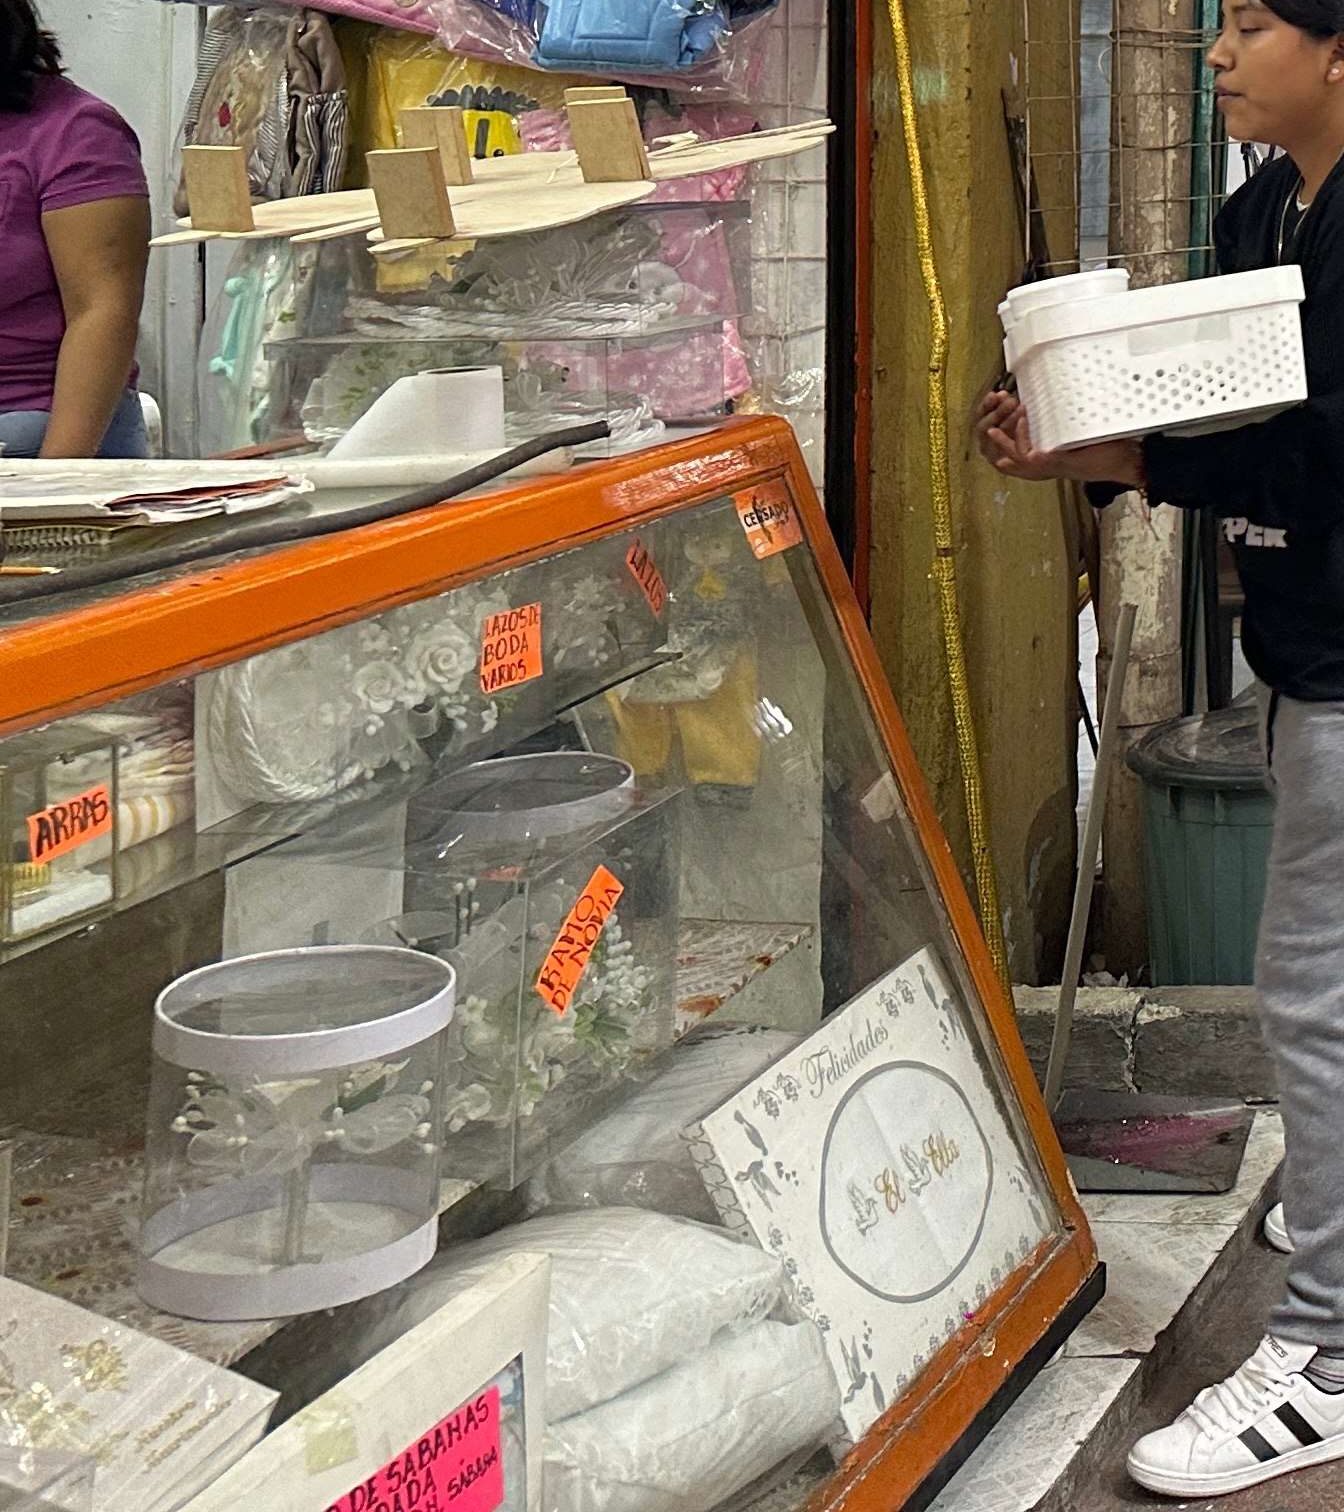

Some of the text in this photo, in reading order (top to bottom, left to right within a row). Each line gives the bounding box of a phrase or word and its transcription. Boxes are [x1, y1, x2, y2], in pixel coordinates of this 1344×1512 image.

[481, 658, 527, 691] VARIOS
[483, 631, 529, 667] BODA
[36, 791, 108, 858] ARRAS
[540, 895, 594, 991] RAMO
[569, 888, 620, 968] NOVIA
[800, 1018, 889, 1100] Felicidades
